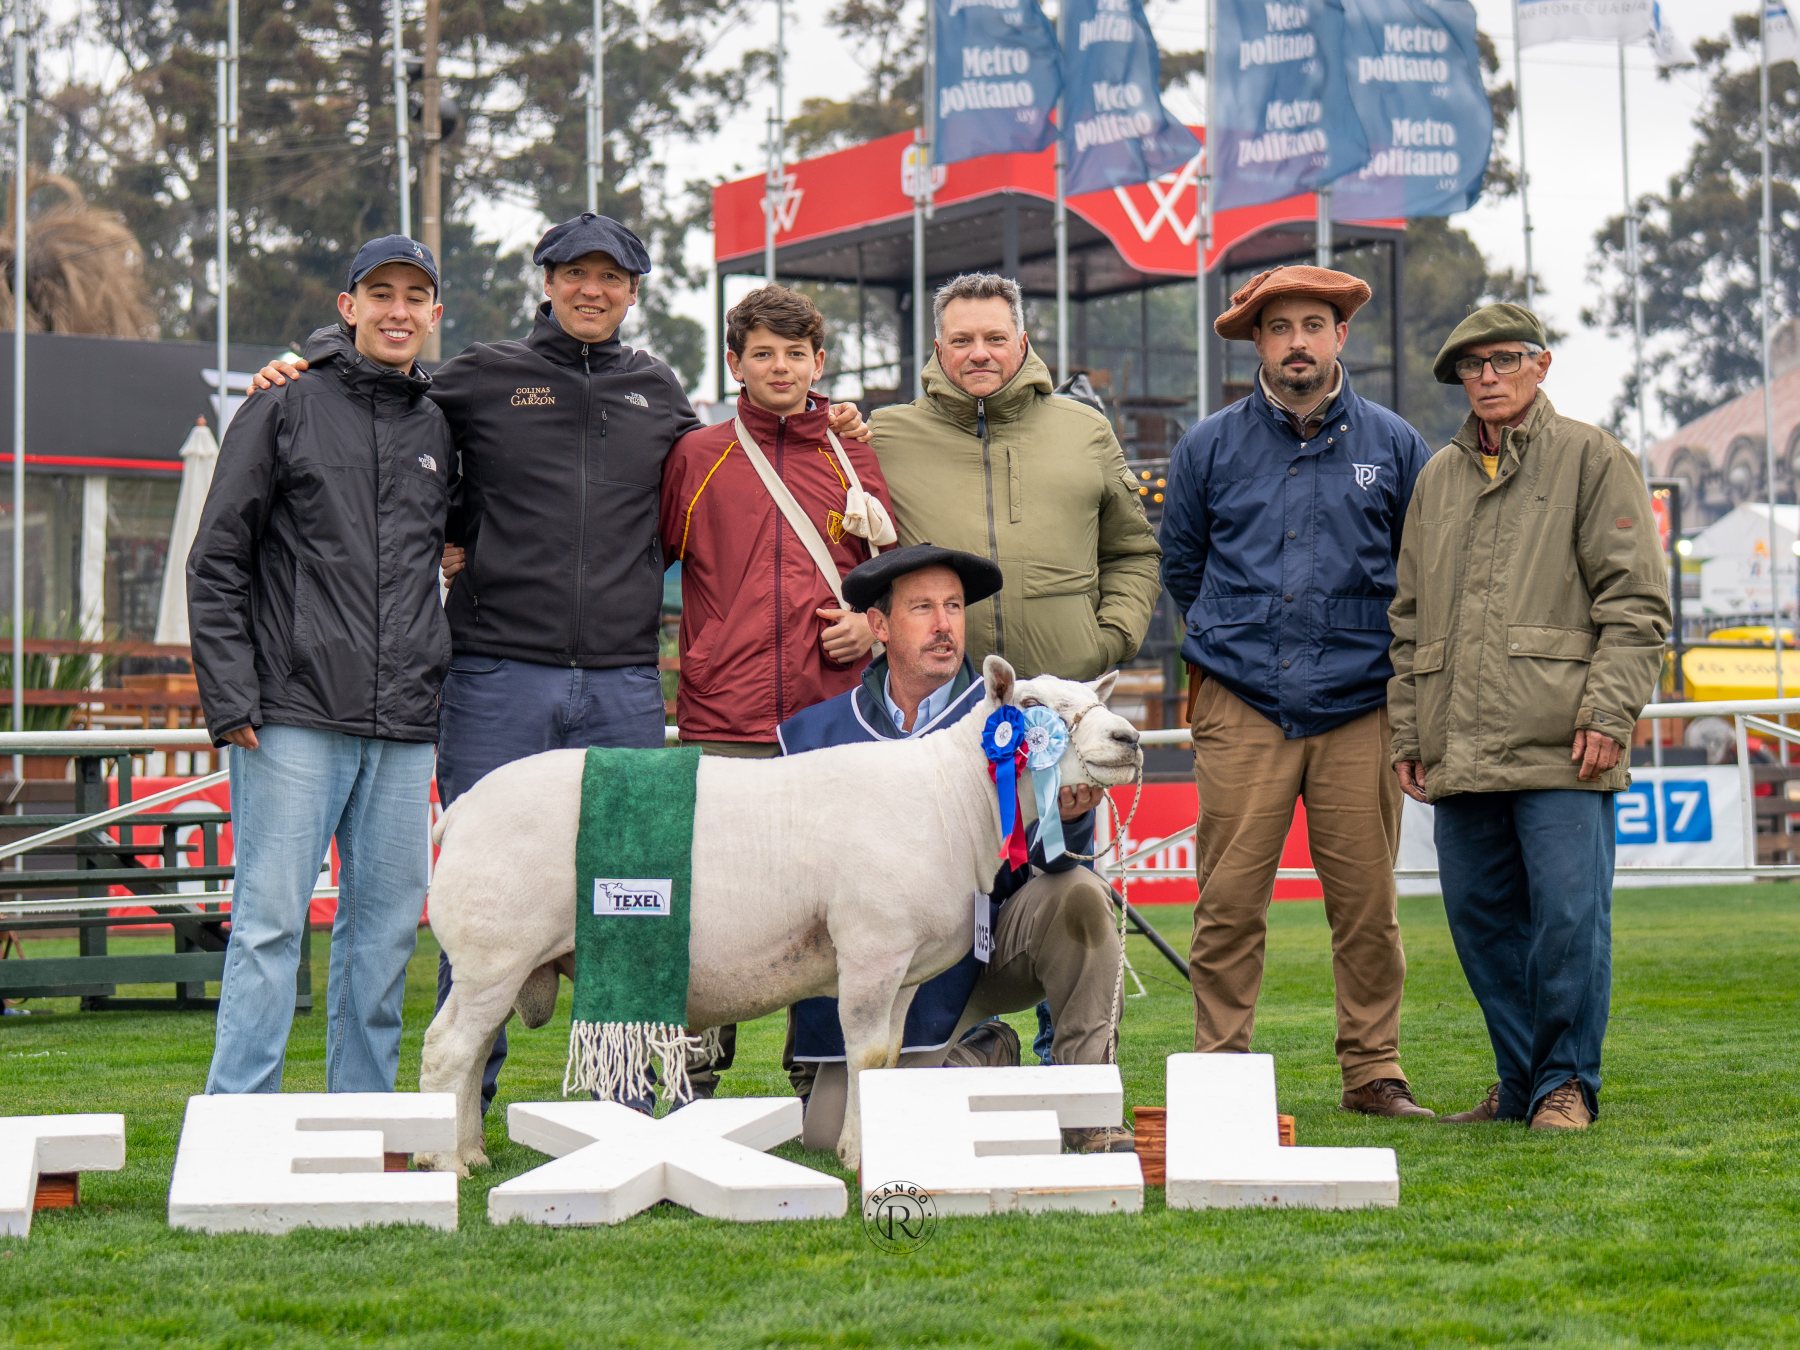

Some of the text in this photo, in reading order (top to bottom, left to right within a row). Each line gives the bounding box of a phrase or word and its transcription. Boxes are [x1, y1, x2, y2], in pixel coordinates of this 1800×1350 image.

[1239, 32, 1316, 71] politano
[1384, 25, 1448, 53] Metro
[962, 45, 1029, 78] Metro
[1358, 54, 1448, 84] politano
[940, 80, 1034, 119] politano
[1265, 99, 1322, 130] Metro
[1392, 118, 1456, 147] Metro
[1237, 129, 1328, 168] politano
[515, 386, 551, 395] COLINAS
[613, 894, 661, 908] TEXEL
